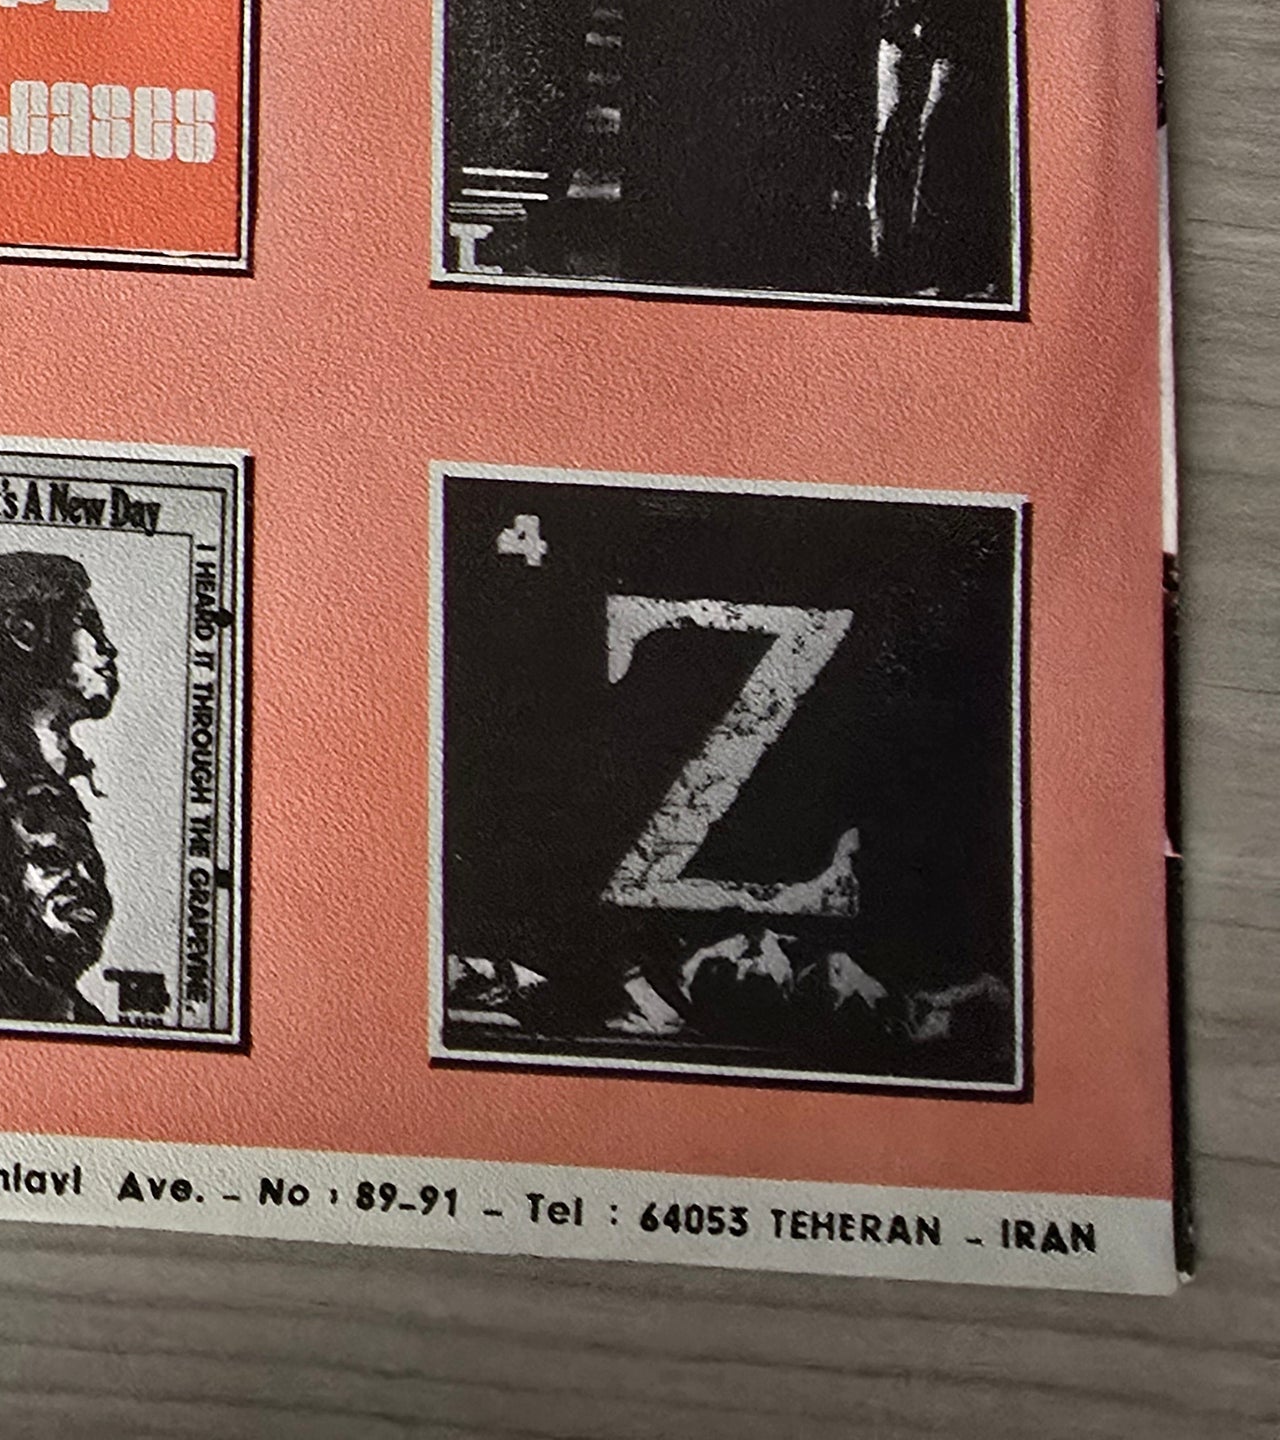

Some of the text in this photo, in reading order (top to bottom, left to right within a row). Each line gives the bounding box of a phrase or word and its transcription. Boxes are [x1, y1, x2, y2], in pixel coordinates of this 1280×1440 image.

[23, 481, 45, 520] A
[49, 482, 106, 525] New
[110, 487, 161, 536] Day
[195, 562, 217, 641] HEARD
[193, 651, 215, 671] IT
[190, 682, 214, 804] THROUGH
[600, 594, 860, 916] Z
[190, 815, 211, 858] THE
[118, 1171, 205, 1203] Ave.
[258, 1177, 310, 1207] No
[526, 1192, 583, 1227] Tel
[640, 1202, 749, 1237] 64053
[770, 1208, 941, 1247] TEHERAN
[1001, 1217, 1098, 1255] IRAN
